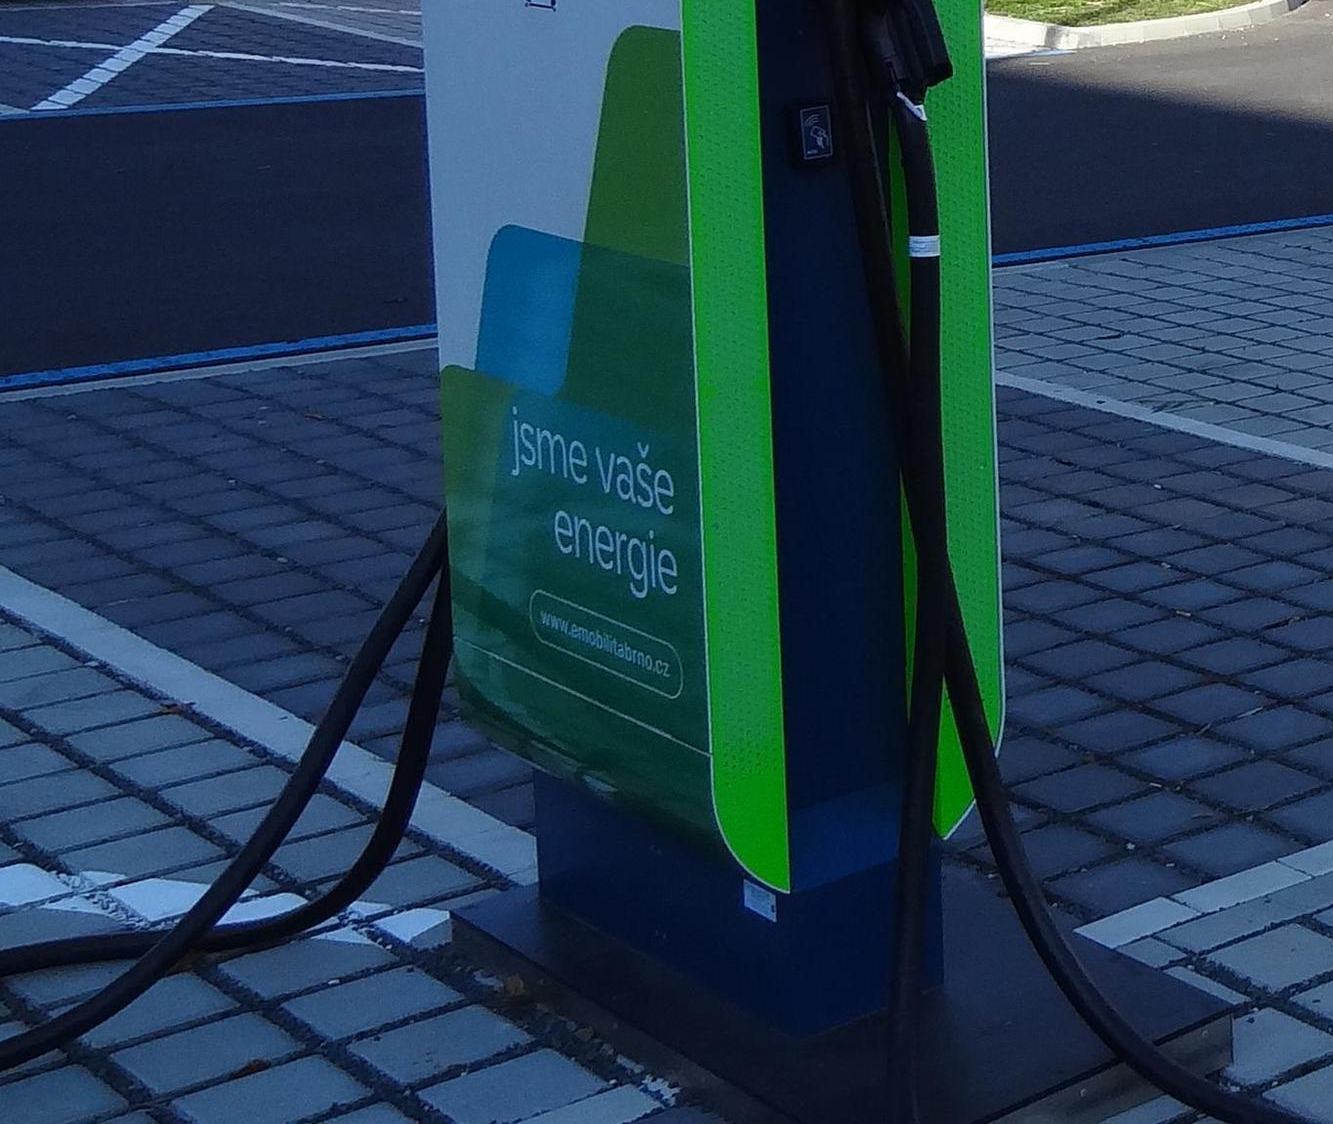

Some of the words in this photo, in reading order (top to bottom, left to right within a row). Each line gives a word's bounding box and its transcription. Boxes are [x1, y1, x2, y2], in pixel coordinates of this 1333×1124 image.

[511, 406, 587, 484] jsme
[595, 441, 674, 515] vaše
[554, 510, 678, 598] energie
[540, 610, 671, 678] www.emobilitabrno.cz
